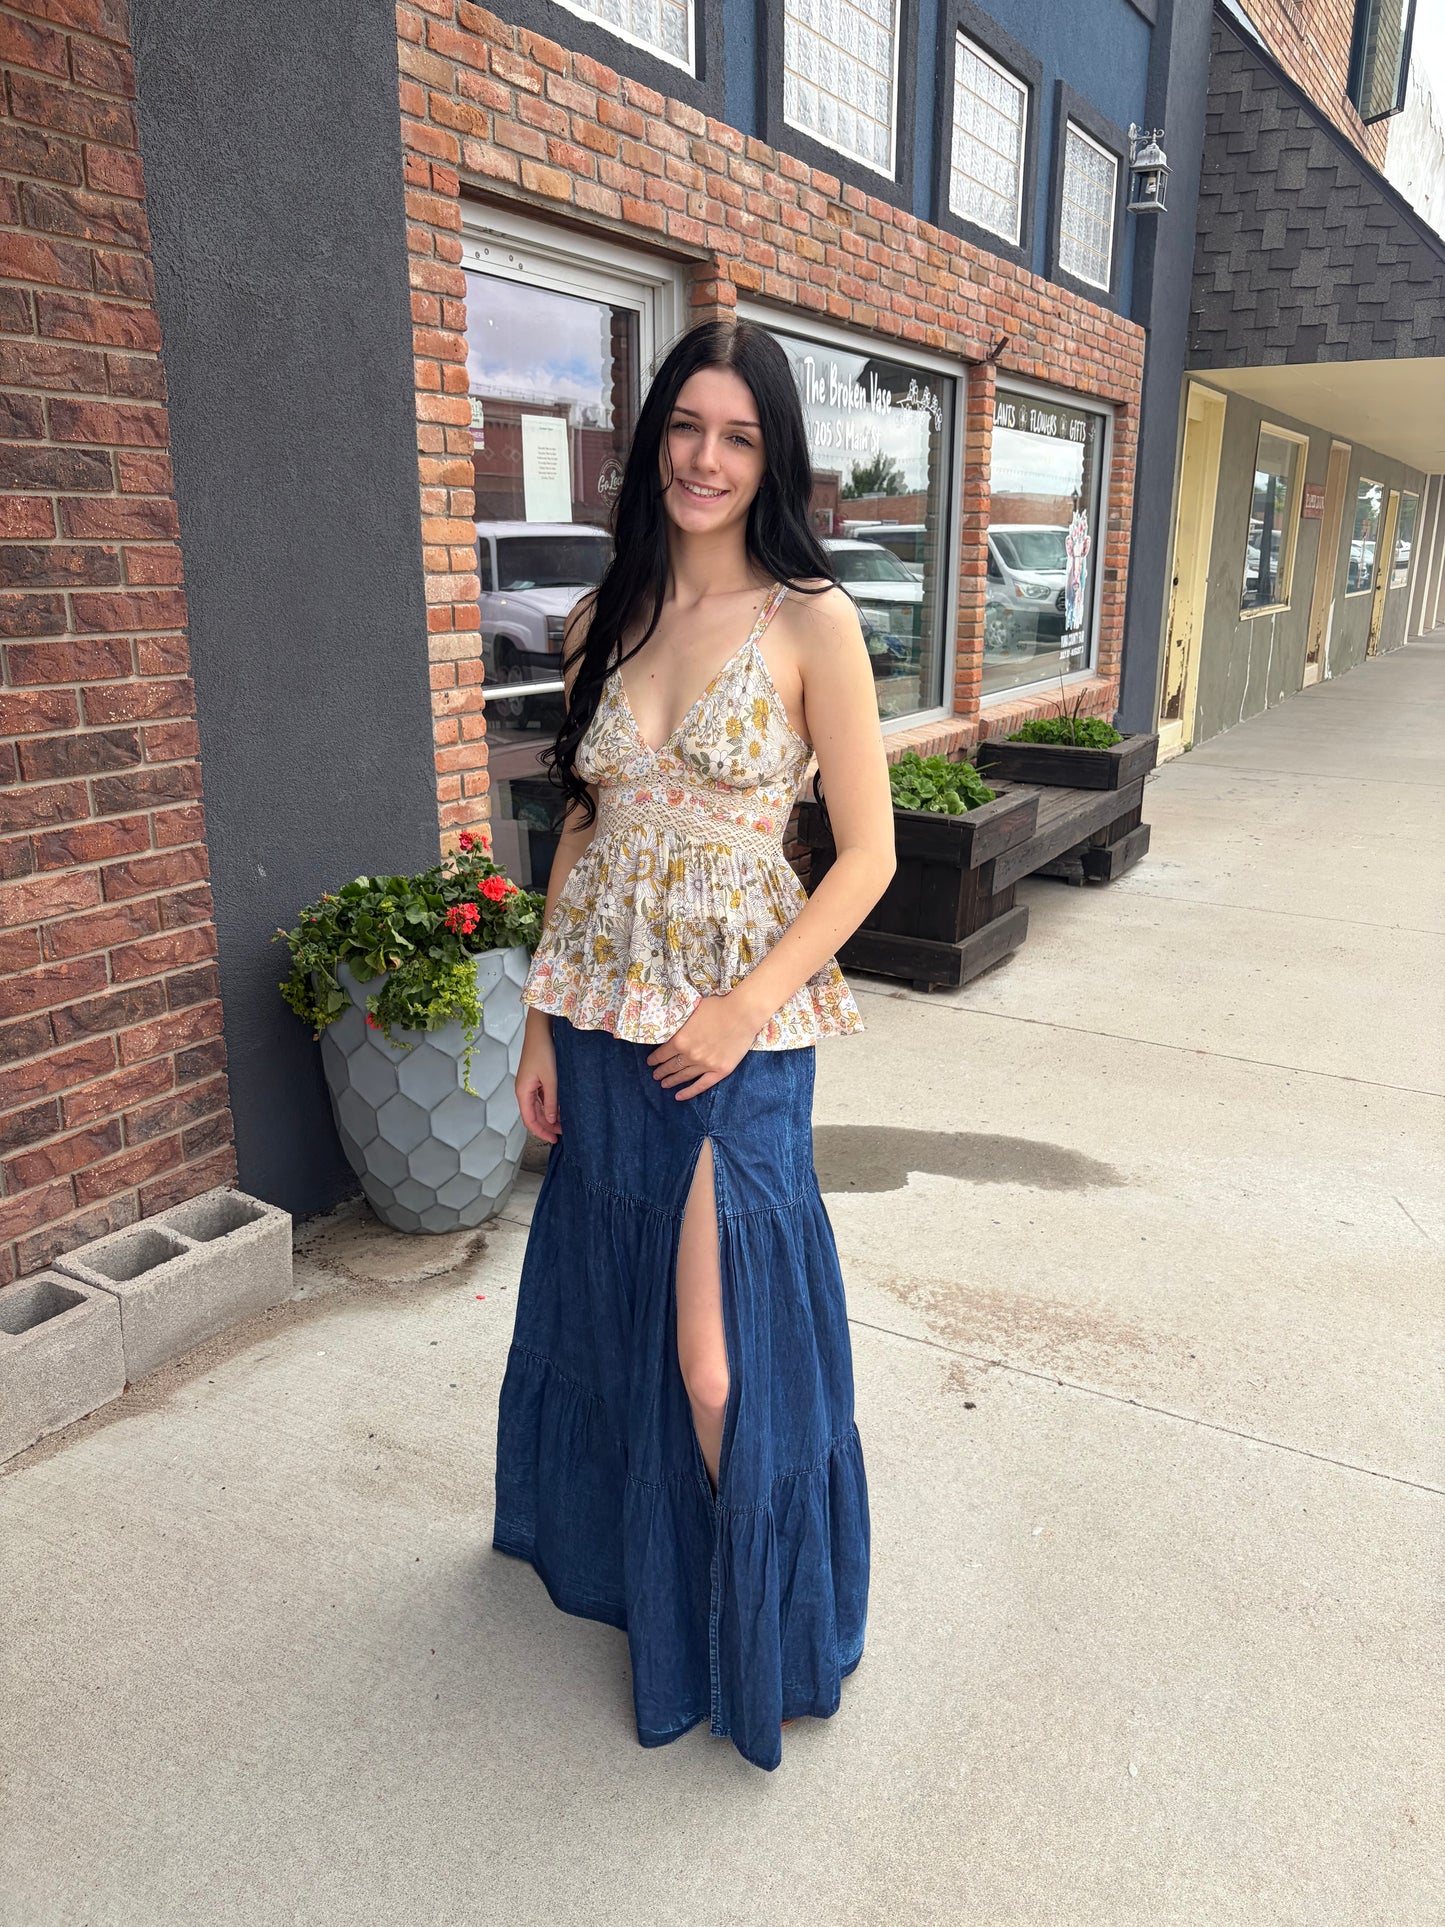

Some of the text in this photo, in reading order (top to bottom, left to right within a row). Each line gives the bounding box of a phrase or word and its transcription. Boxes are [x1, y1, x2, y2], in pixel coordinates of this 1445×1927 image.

[804, 356, 892, 416] The Broken Vase
[814, 419, 881, 452] 205 S Main St
[993, 401, 1087, 442] LANTS FLOWERS GIFTS
